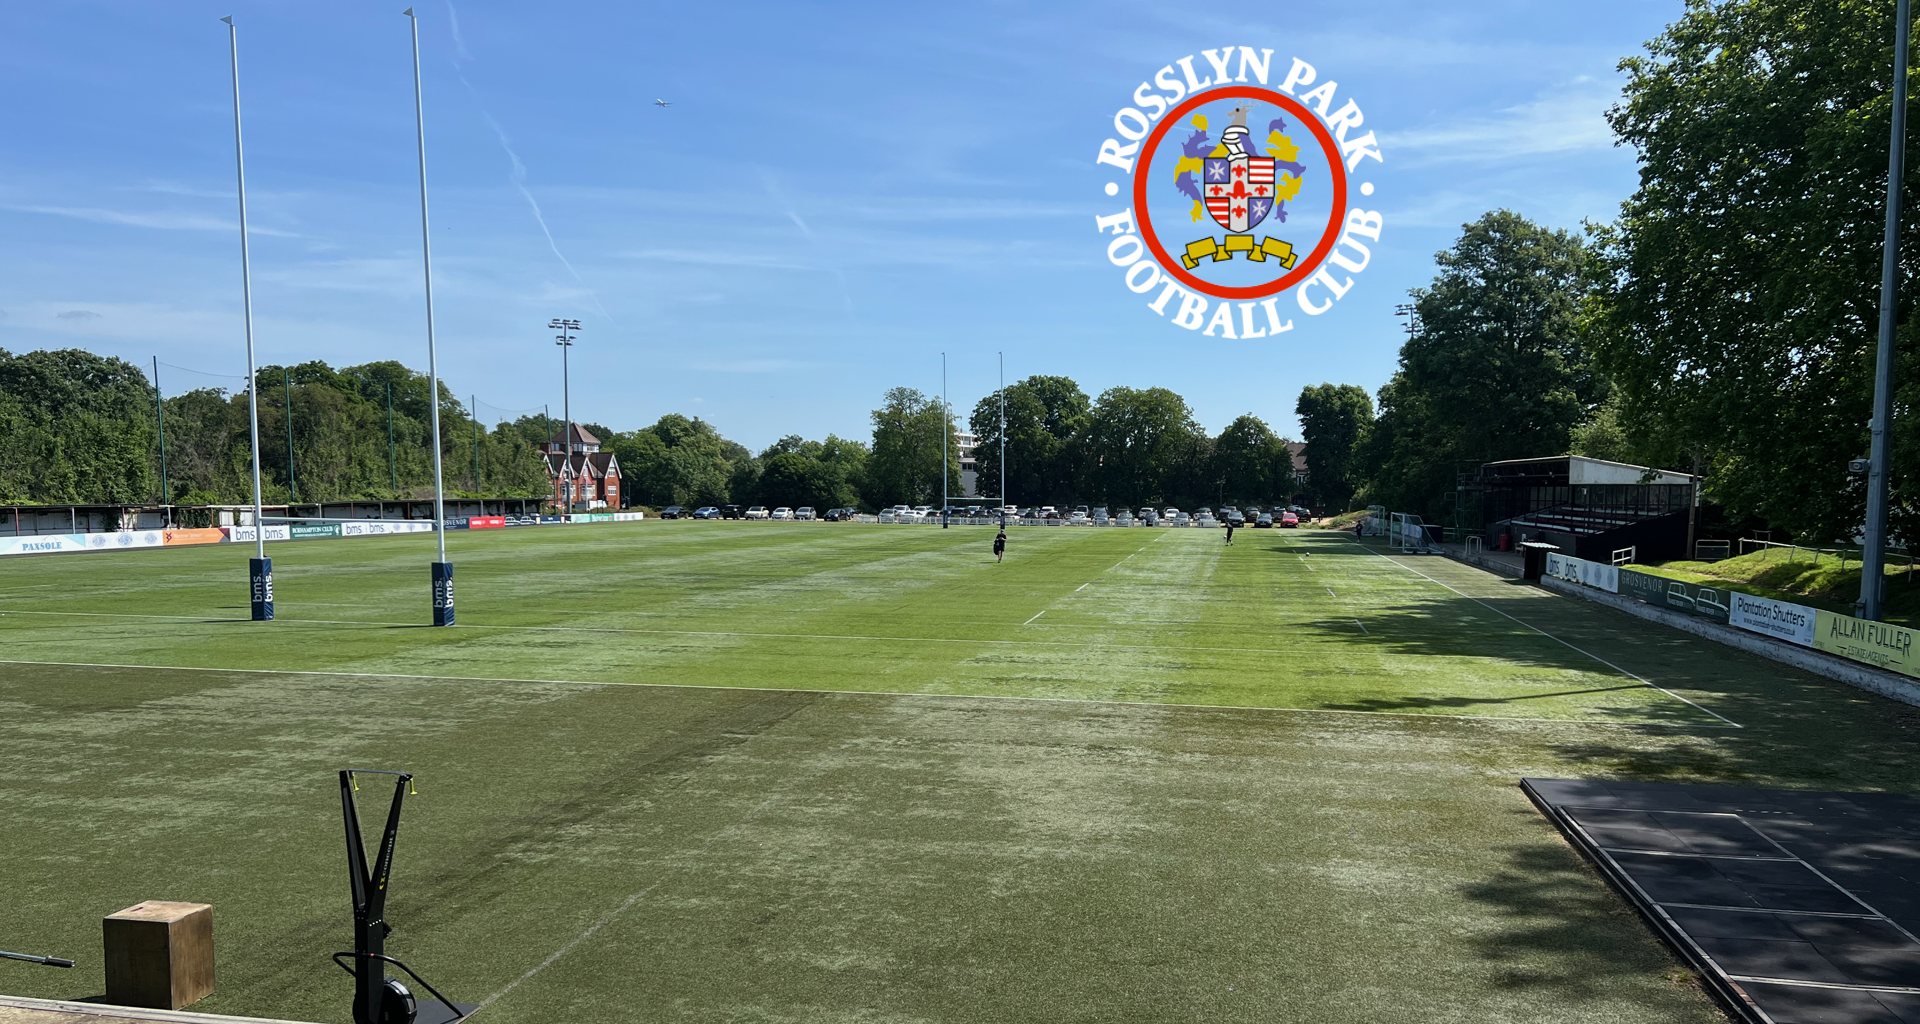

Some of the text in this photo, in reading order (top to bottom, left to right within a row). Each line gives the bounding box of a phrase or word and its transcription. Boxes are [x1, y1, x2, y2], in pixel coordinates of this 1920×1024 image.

[435, 518, 467, 526] OSVENOR
[22, 541, 62, 551] PAXSOLE
[1621, 571, 1663, 593] GROSVENOR
[1737, 597, 1772, 619] Plantation
[1772, 604, 1805, 627] Shutters
[1830, 616, 1911, 660] ALLAN FULLER
[1847, 645, 1889, 665] ESTATE AGENTS
